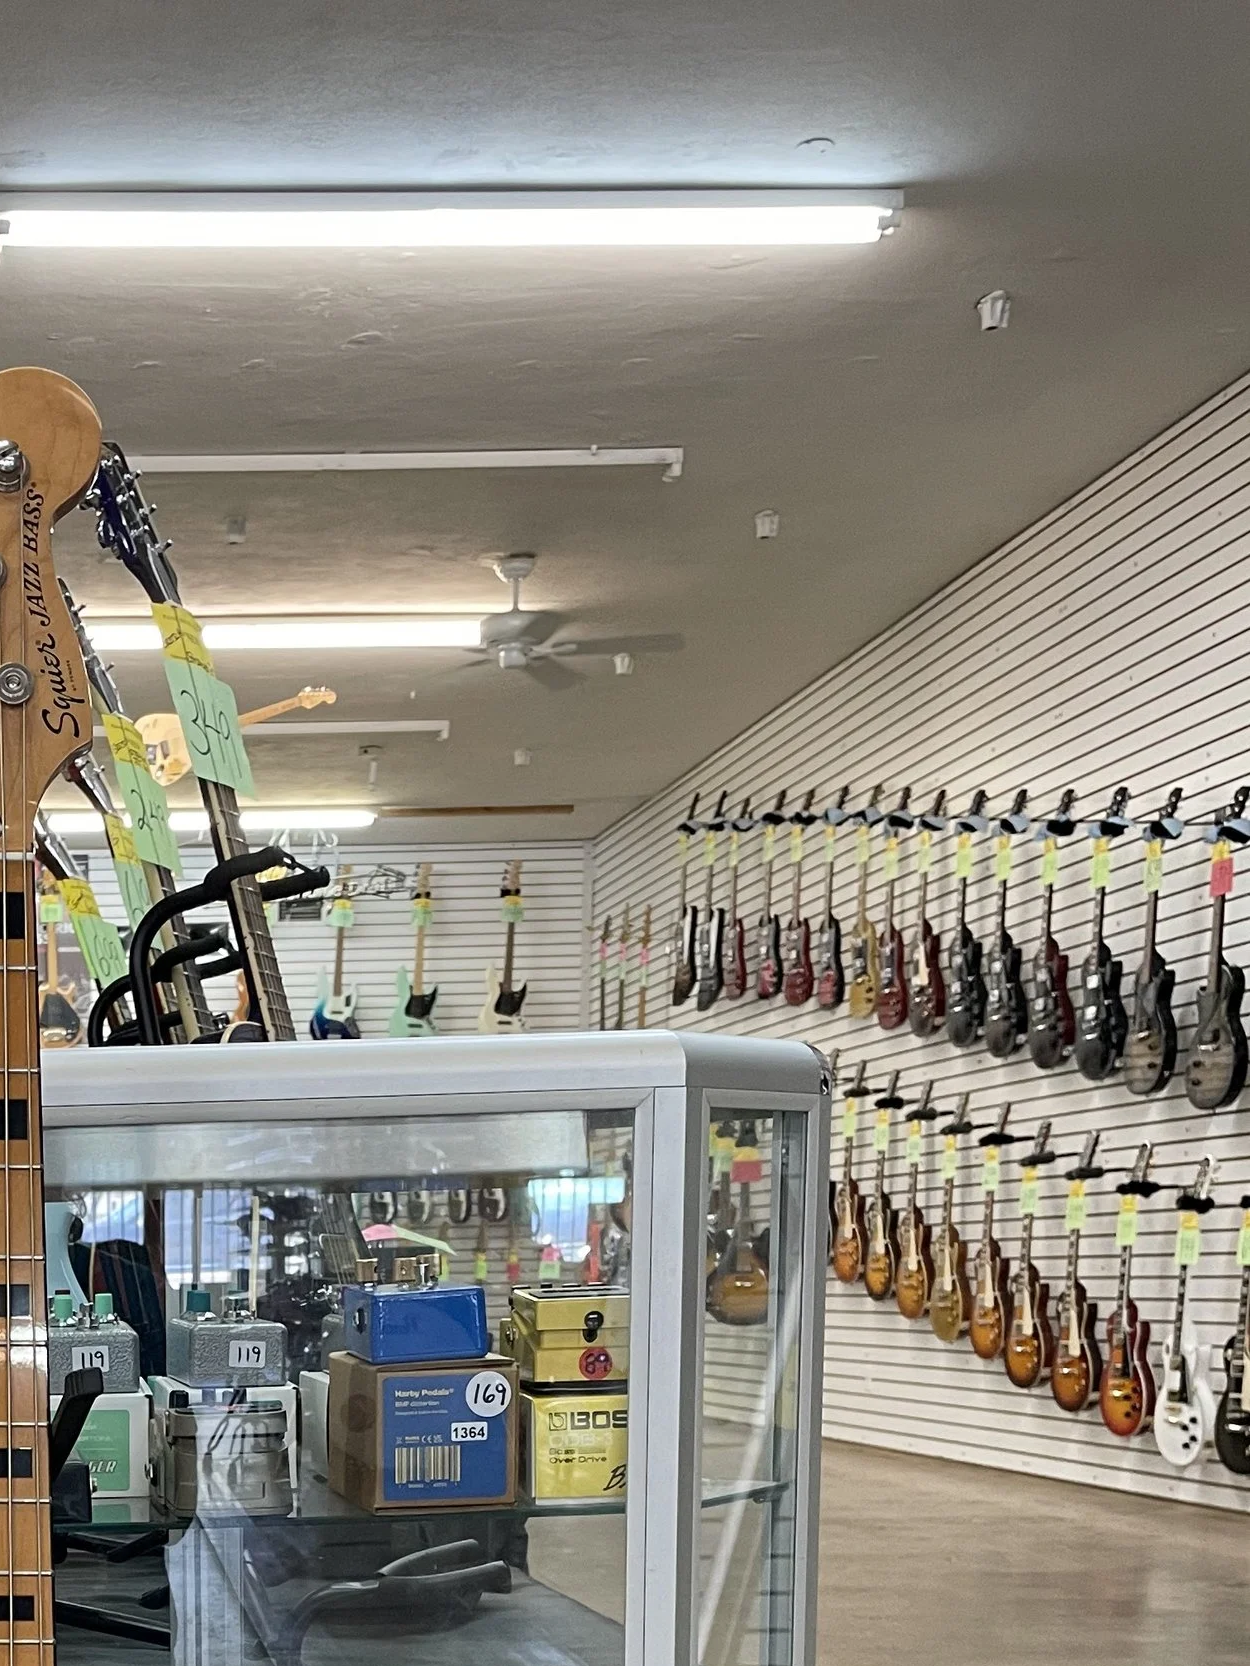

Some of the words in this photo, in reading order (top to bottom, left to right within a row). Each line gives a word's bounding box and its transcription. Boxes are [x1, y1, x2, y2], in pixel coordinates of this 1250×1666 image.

[22, 487, 45, 556] BASS
[24, 563, 51, 627] JAZZ
[41, 632, 85, 738] Squier
[180, 689, 243, 780] 349
[81, 1350, 105, 1369] 119
[237, 1345, 262, 1364] 119
[473, 1383, 507, 1406] 169
[570, 1410, 627, 1430] BOS
[453, 1426, 485, 1439] 1364
